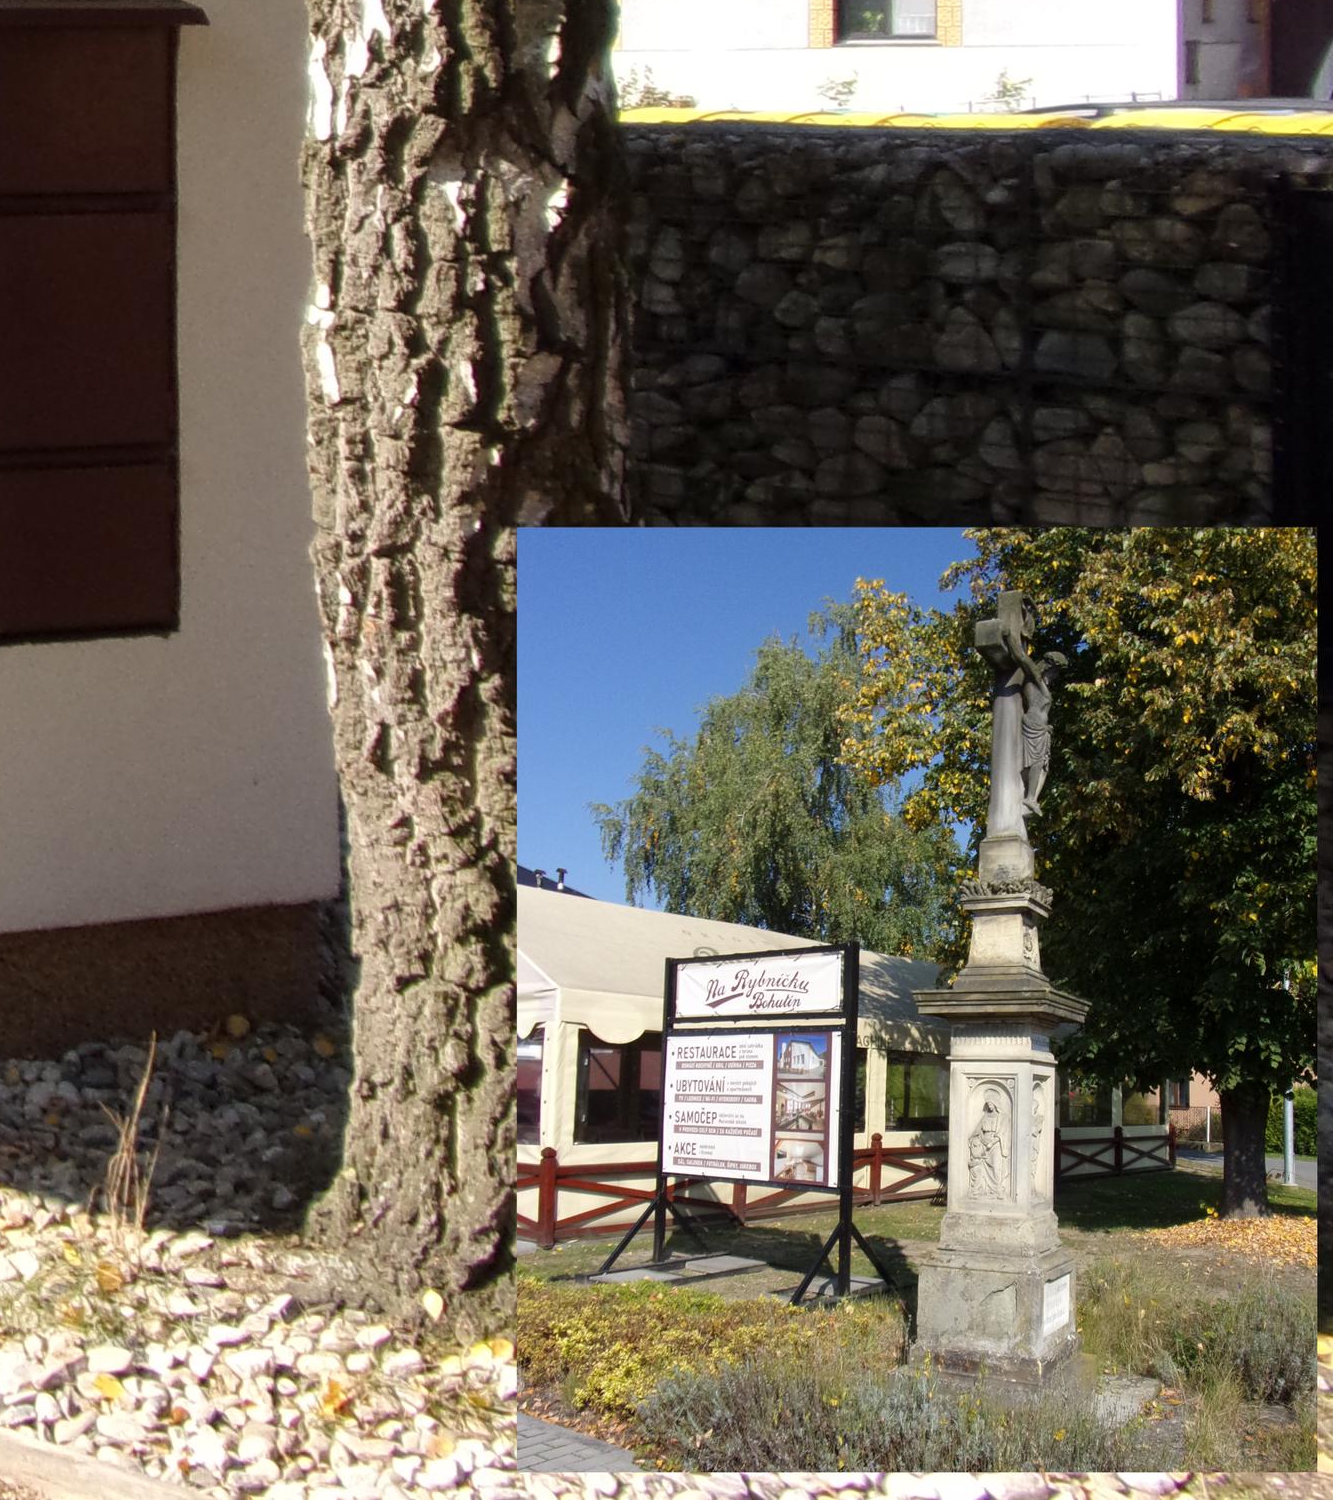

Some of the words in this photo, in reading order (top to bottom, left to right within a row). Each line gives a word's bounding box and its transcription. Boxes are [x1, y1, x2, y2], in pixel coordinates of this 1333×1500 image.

[706, 979, 726, 1002] Na
[731, 969, 811, 997] Rybníčku
[749, 992, 802, 1010] Bohutín
[677, 1045, 737, 1060] RESTAURACE
[675, 1076, 726, 1093] UBYTOVÁNÍ
[674, 1107, 718, 1125] SAMOČEP
[674, 1143, 697, 1157] AKCE
